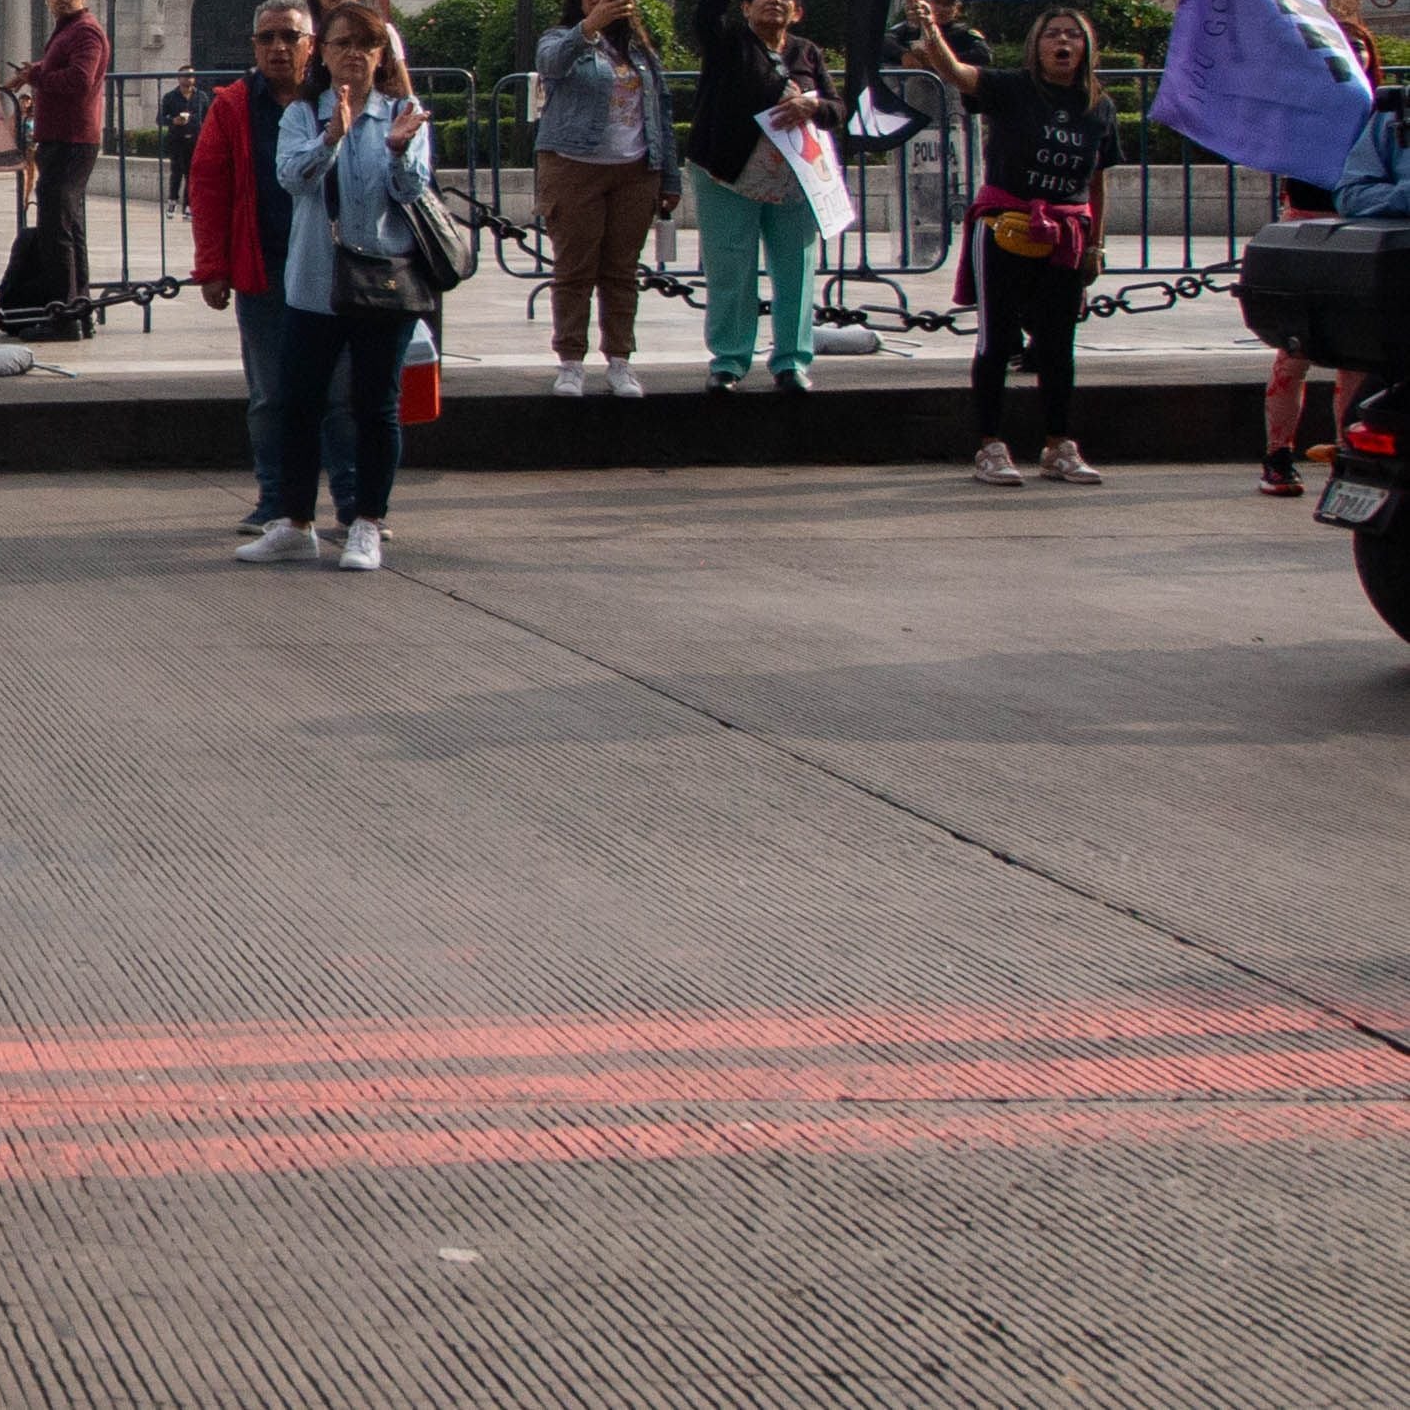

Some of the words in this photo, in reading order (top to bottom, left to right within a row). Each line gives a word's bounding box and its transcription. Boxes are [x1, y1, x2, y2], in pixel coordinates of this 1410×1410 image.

[1043, 125, 1083, 146] YOU
[1036, 149, 1084, 169] GOT
[1027, 170, 1077, 192] THIS
